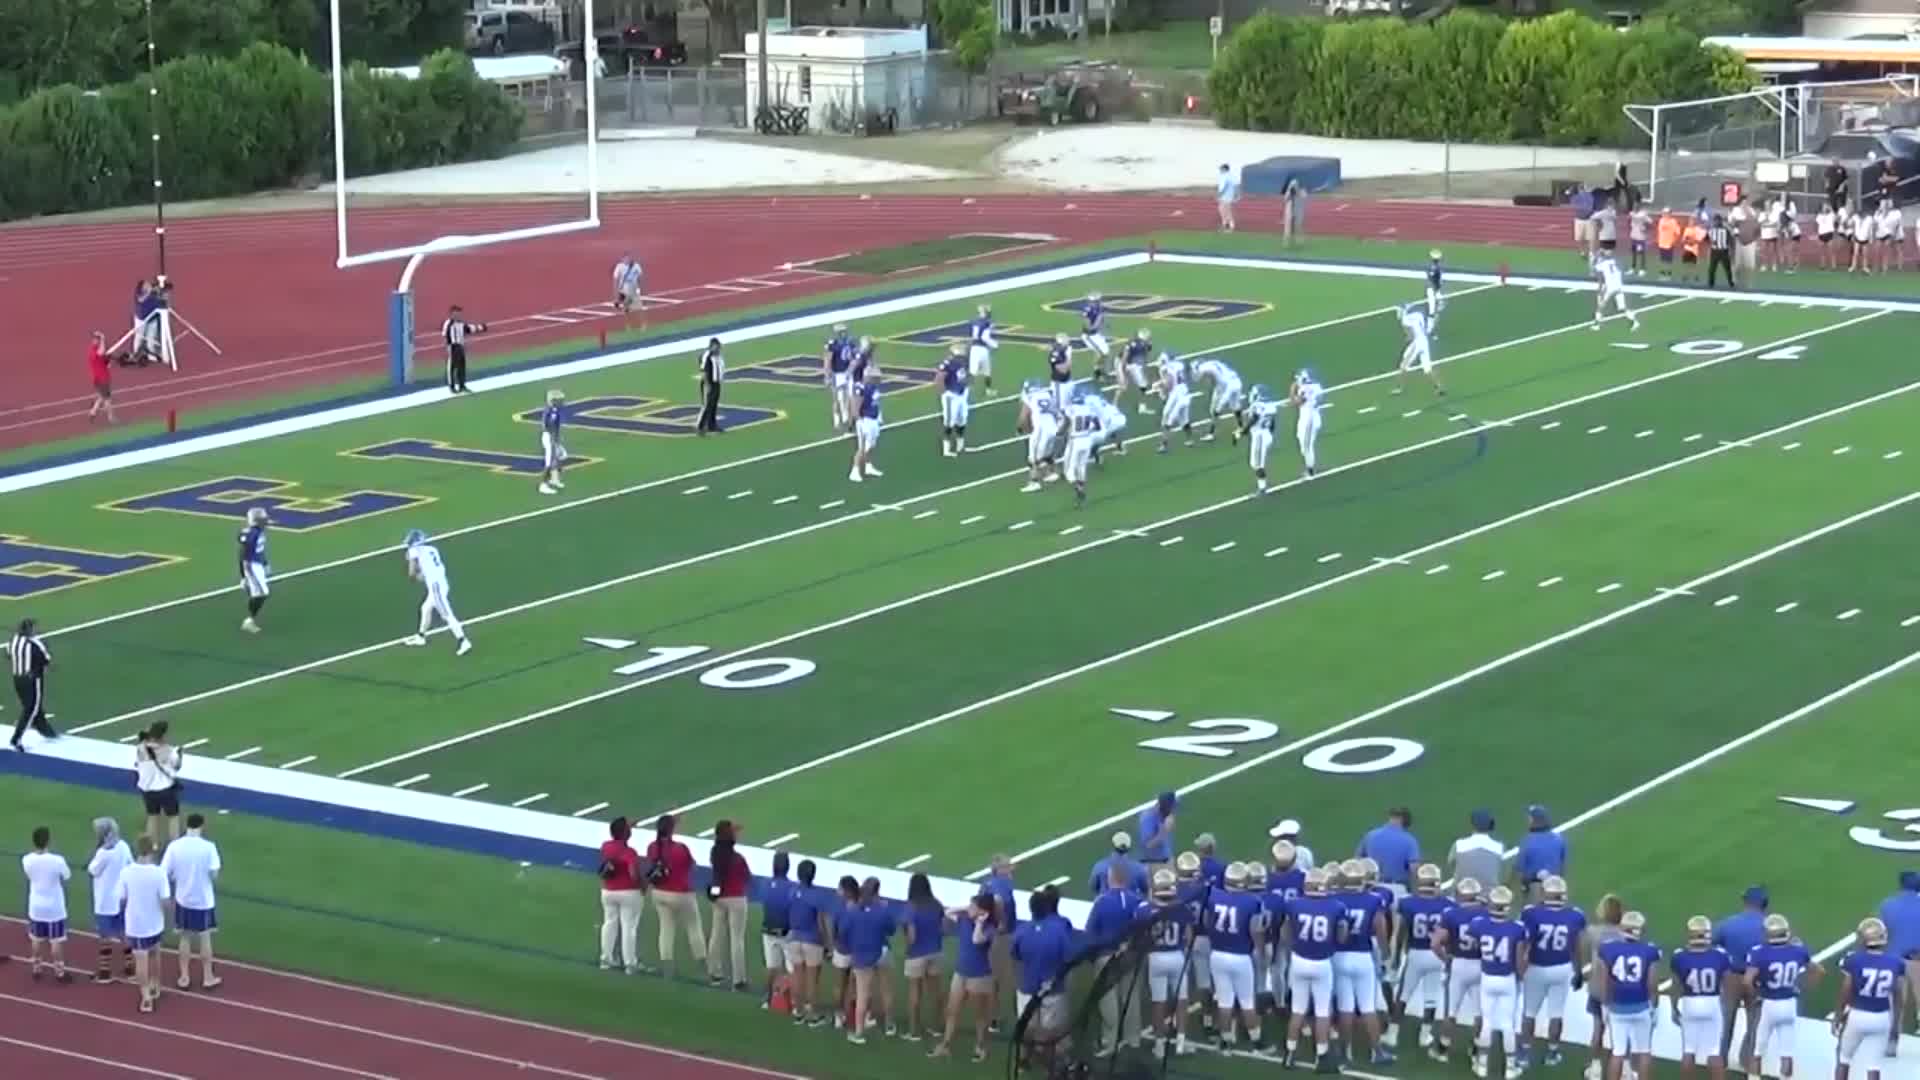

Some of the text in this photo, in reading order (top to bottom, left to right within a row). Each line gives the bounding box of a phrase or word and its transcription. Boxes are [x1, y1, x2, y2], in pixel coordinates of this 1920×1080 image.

[612, 646, 816, 688] 10
[1136, 718, 1424, 773] 20
[1214, 904, 1238, 934] 71
[1298, 914, 1328, 941] 78
[1345, 908, 1365, 934] 7
[1459, 923, 1478, 950] 5
[1480, 935, 1509, 962] 24
[1538, 924, 1568, 950] 76
[1612, 955, 1641, 981] 43
[1686, 968, 1715, 992] 40
[1768, 961, 1797, 989] 30
[1859, 968, 1893, 997] 72
